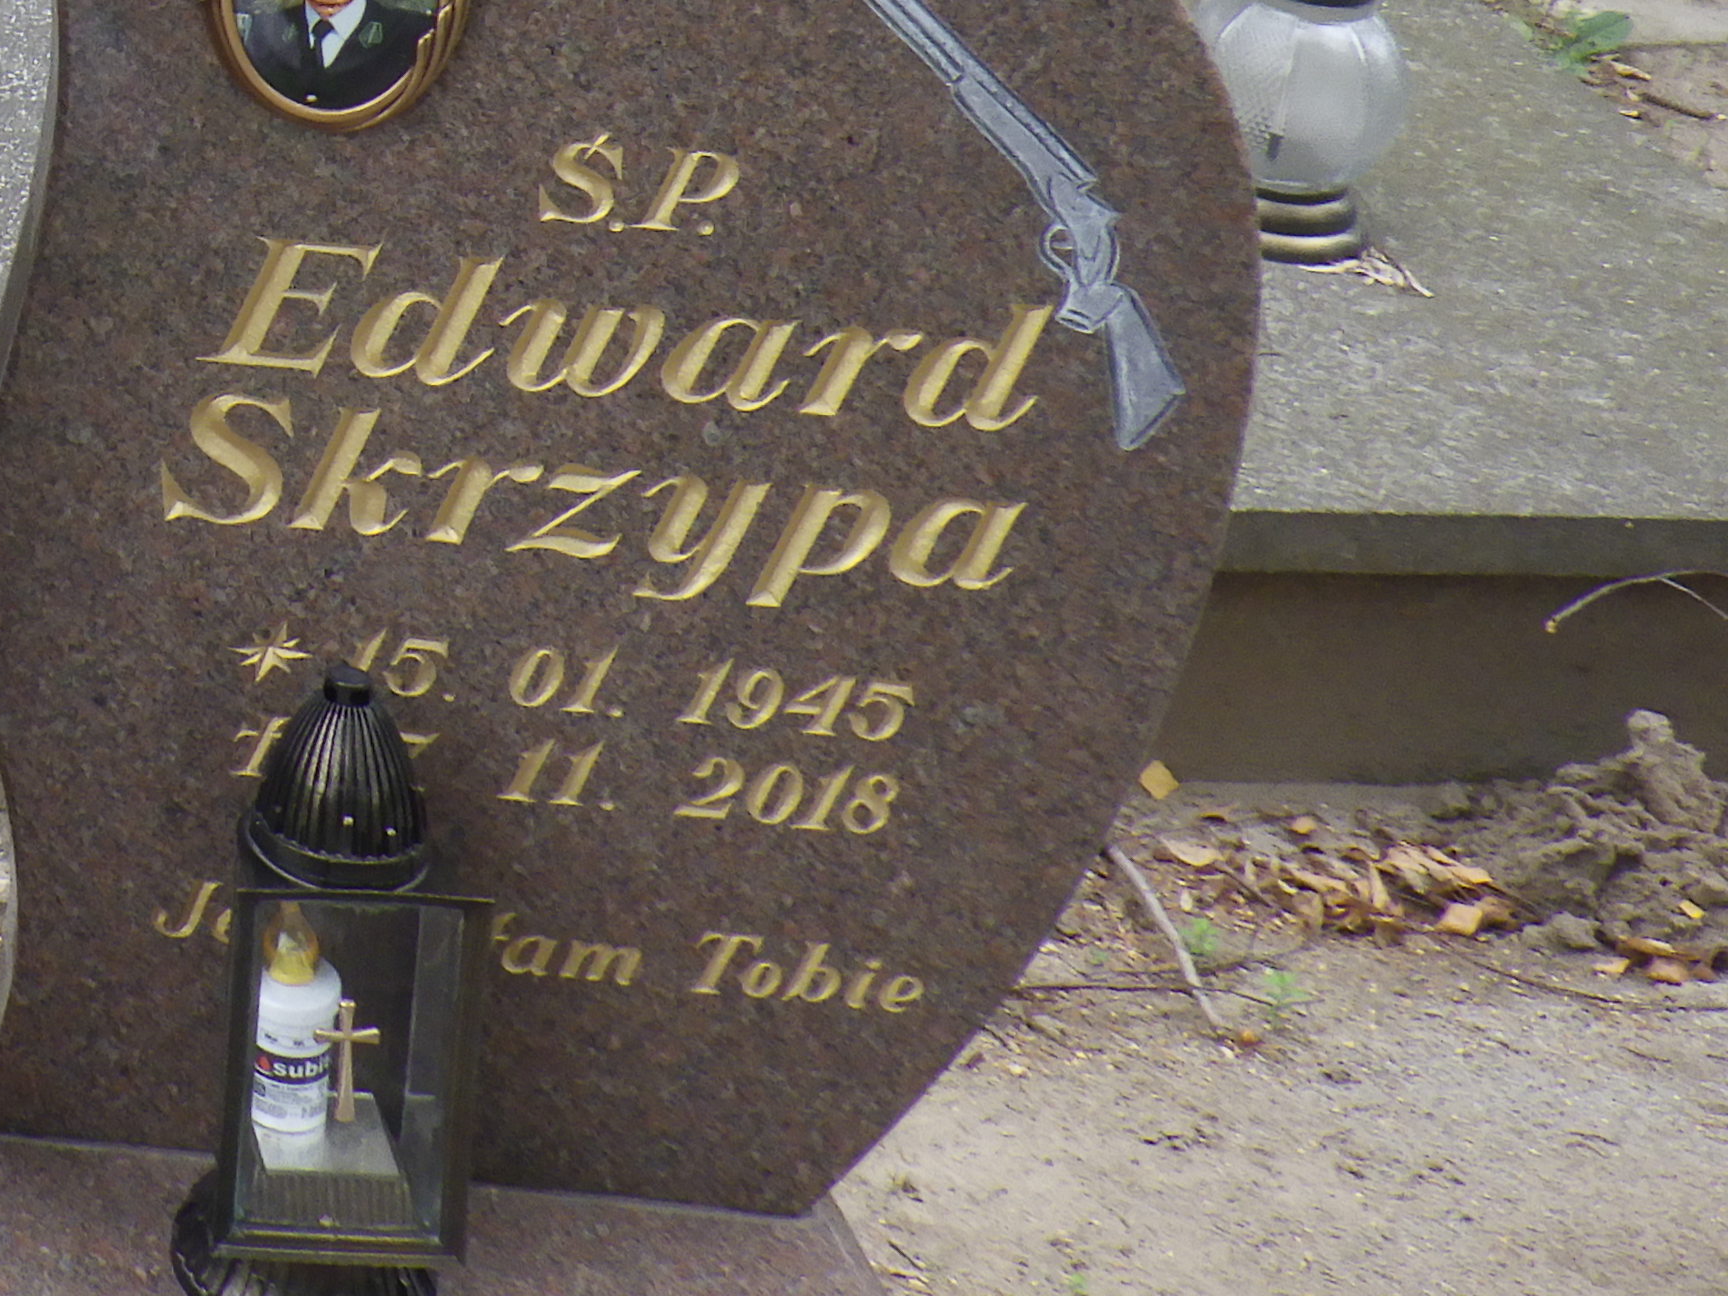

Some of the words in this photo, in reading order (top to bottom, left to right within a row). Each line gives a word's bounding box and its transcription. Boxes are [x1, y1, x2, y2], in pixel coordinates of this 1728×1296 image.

[195, 235, 1055, 433] Edward
[160, 392, 1028, 609] Skrzypa
[509, 644, 625, 720] 01.
[676, 657, 917, 742] 1945
[496, 738, 616, 812] 11.
[674, 756, 901, 835] 2018
[691, 931, 926, 1014] Tobie
